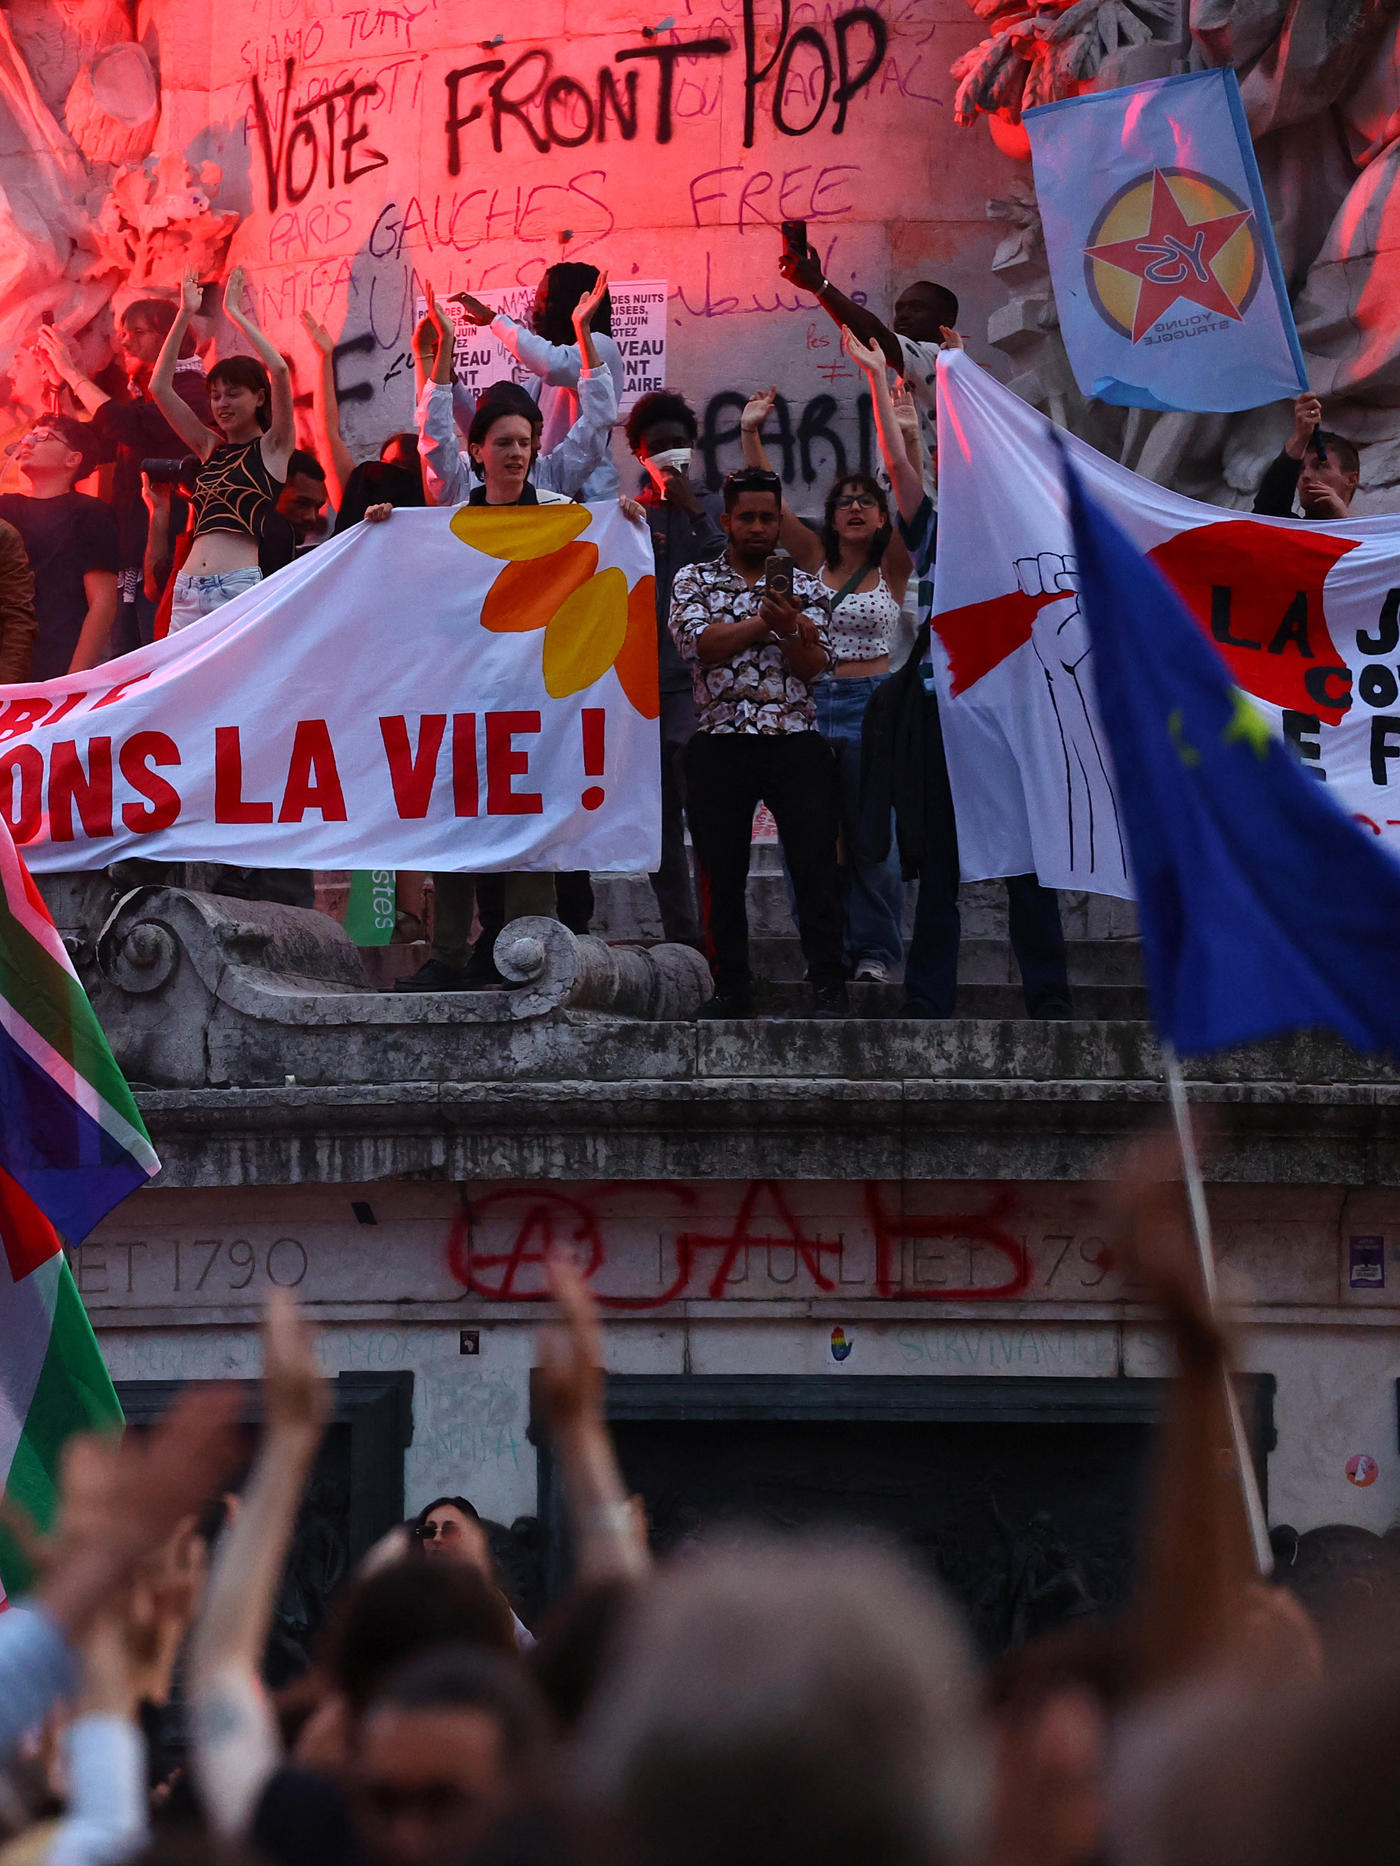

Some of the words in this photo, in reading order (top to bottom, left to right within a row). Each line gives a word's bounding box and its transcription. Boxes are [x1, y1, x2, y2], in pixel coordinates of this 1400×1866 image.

[251, 57, 388, 213] VOTE
[444, 37, 731, 176] FRONT
[743, 0, 888, 148] POP
[369, 170, 614, 260] GAUCHES
[689, 164, 861, 235] FREE
[269, 200, 353, 261] PARIS
[445, 307, 461, 317] DES
[611, 295, 630, 304] DES
[634, 294, 664, 303] NUITS
[624, 316, 648, 326] JUIN
[456, 327, 477, 337] JUIN
[612, 328, 637, 337] OTEZ
[616, 340, 664, 356] VEAU
[452, 350, 491, 367] VEAU
[1211, 585, 1314, 658] LA
[1356, 587, 1400, 655] J
[1304, 663, 1400, 708] CO
[215, 719, 348, 825] LA
[379, 710, 543, 819] VIE
[581, 708, 605, 812] !
[372, 870, 395, 929] stes
[164, 1237, 308, 1291] 1790
